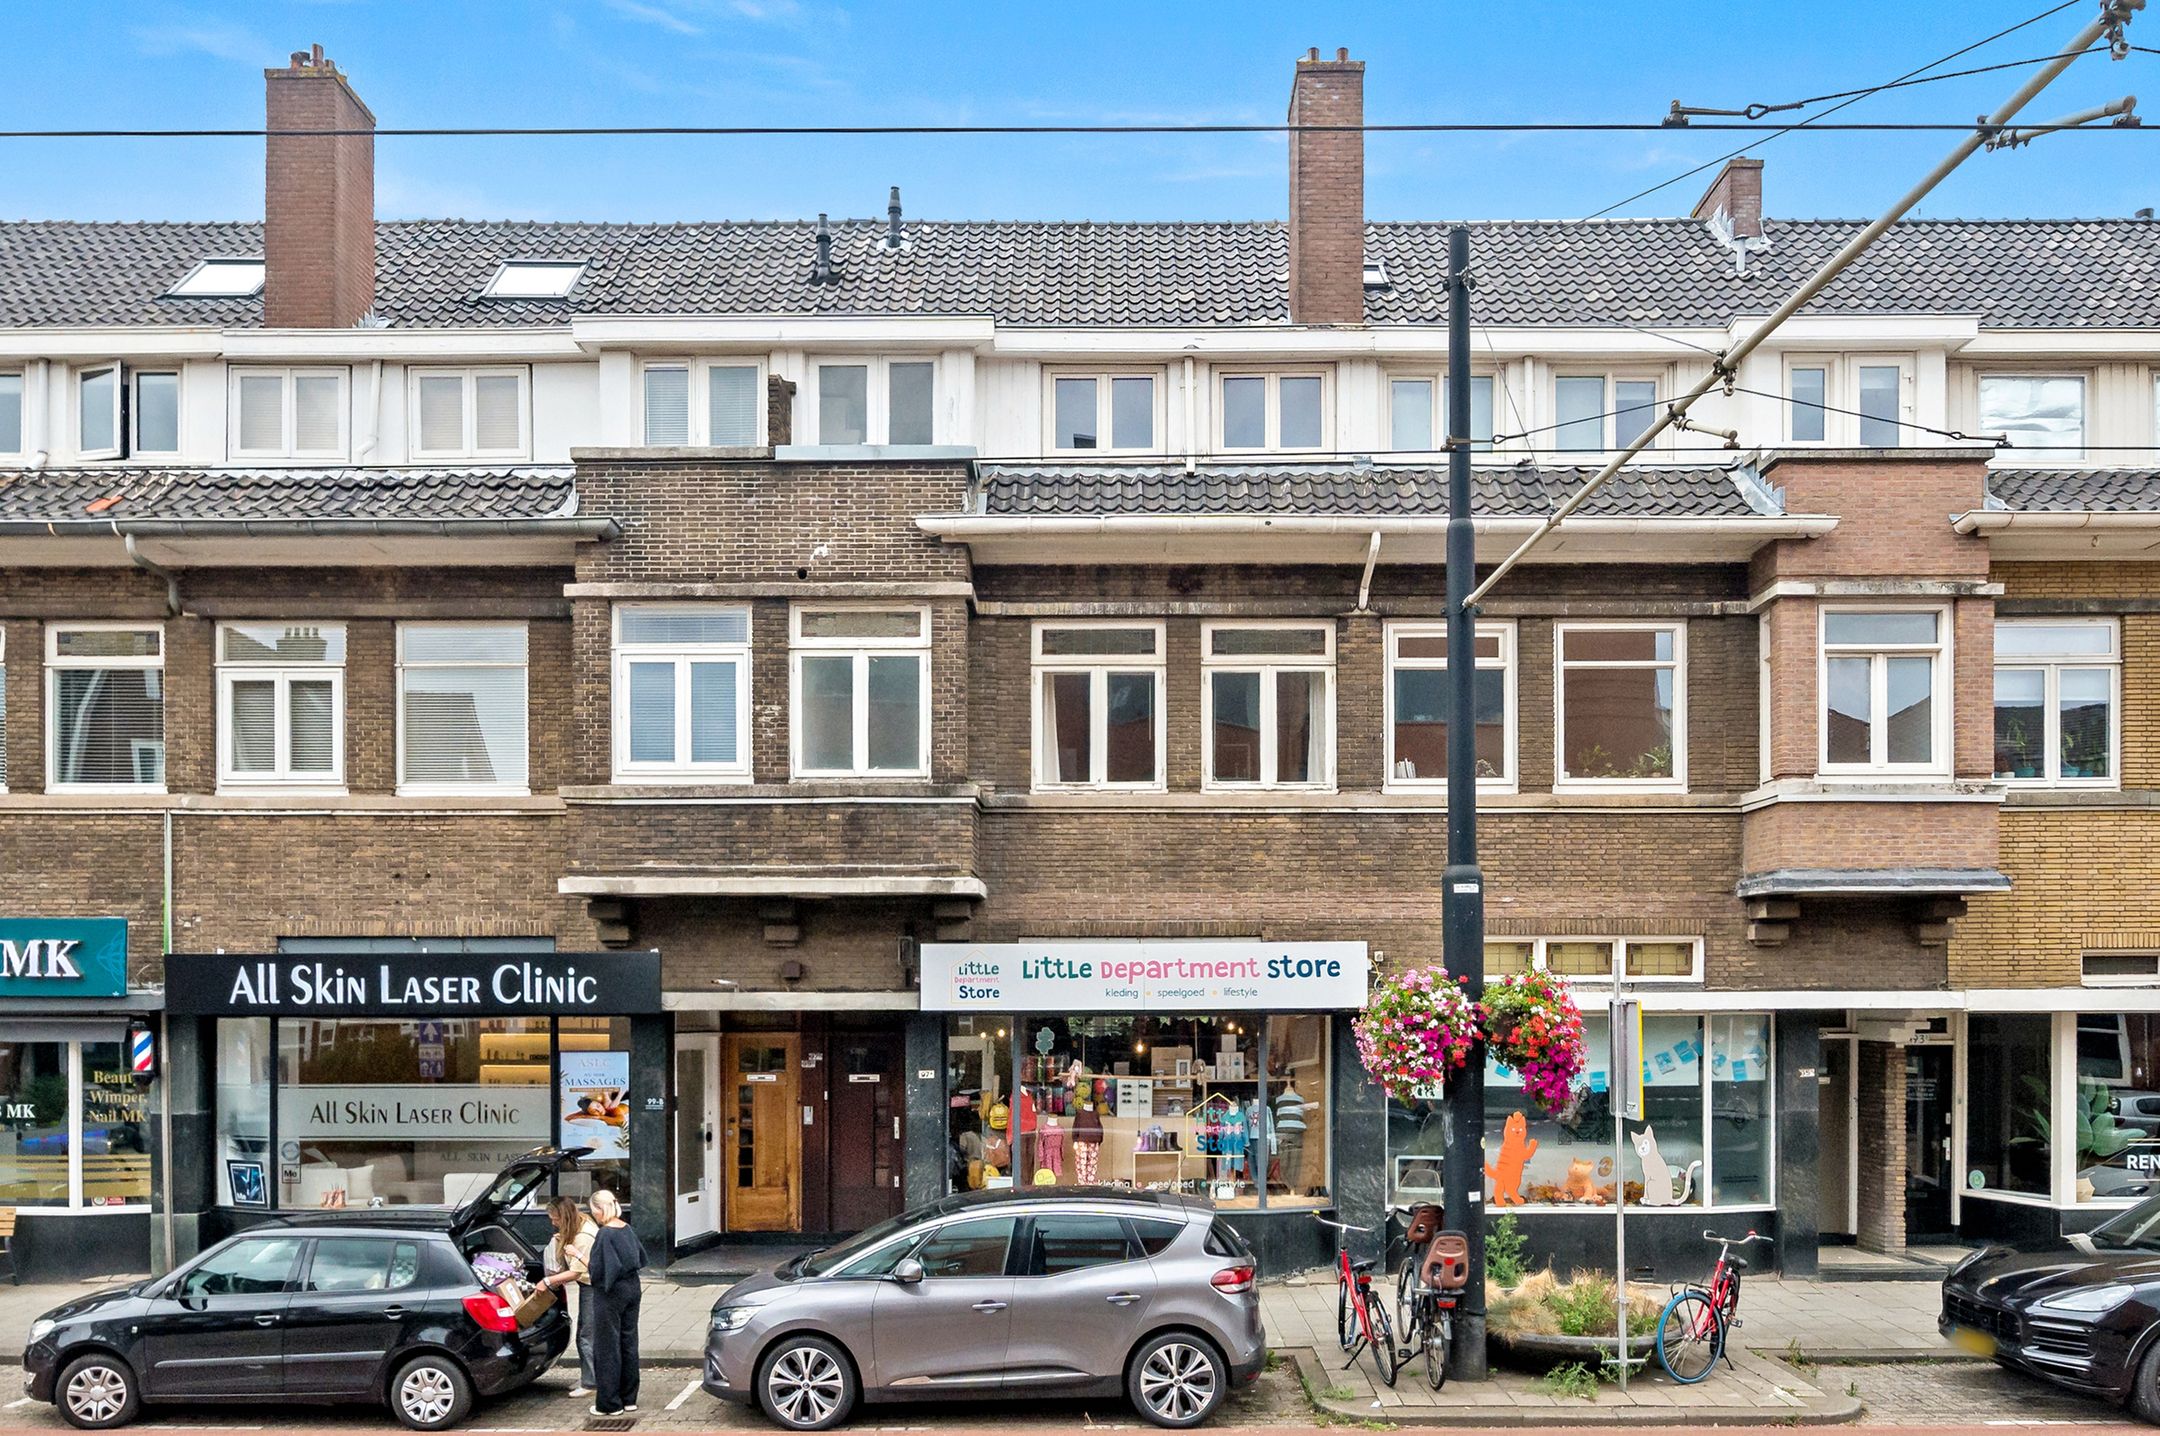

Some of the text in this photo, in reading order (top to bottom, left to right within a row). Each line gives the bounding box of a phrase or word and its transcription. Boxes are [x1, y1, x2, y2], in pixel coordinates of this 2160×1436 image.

[0, 939, 80, 977] MK
[229, 963, 280, 1004] All
[959, 985, 1000, 998] Store
[1106, 987, 1258, 999] kleding speelgoed lifestyle
[93, 1070, 137, 1087] Beaut
[565, 1078, 626, 1086] MASSAGES
[6, 1103, 36, 1119] MK
[89, 1109, 147, 1122] Nail MK
[310, 1101, 338, 1124] All
[2126, 1154, 2160, 1170] REN
